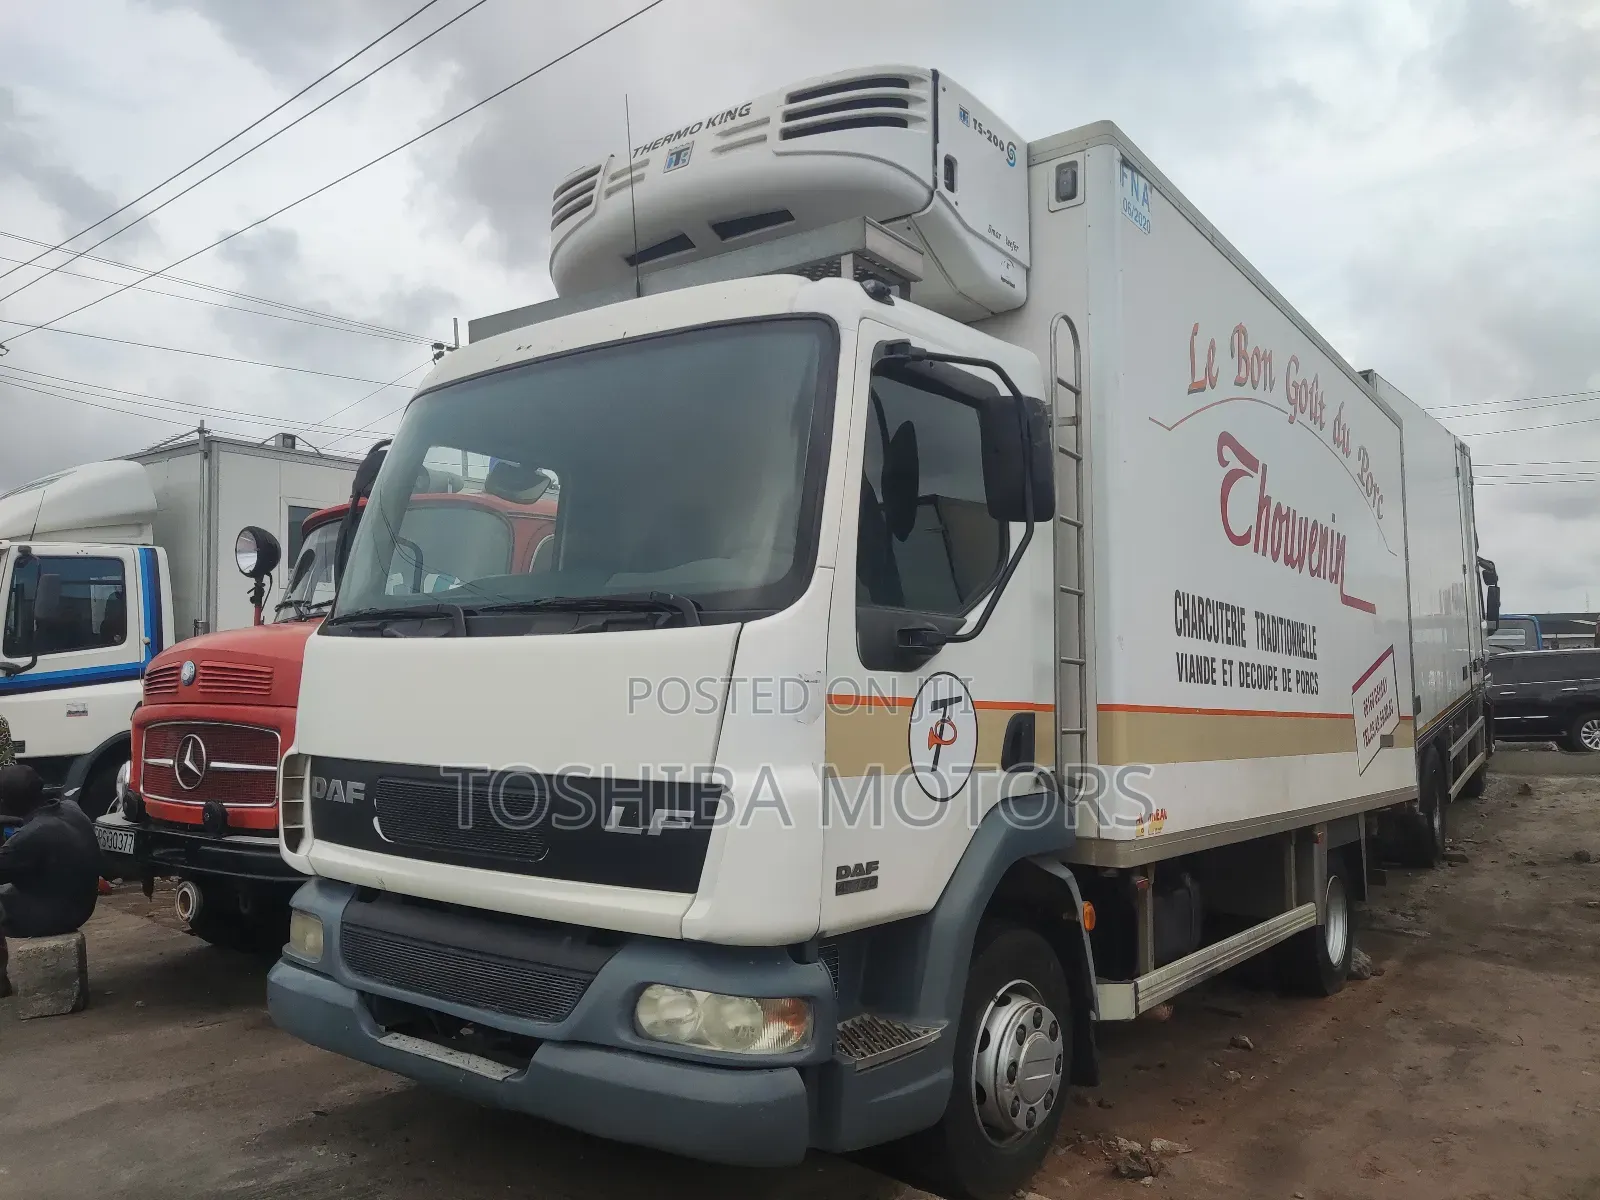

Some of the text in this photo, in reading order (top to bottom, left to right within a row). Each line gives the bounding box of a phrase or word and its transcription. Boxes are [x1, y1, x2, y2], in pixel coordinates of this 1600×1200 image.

[632, 102, 752, 158] THERMO KING
[973, 118, 1005, 152] TS-200
[1123, 197, 1151, 234] 06/2020
[1187, 322, 1219, 395] Le
[1230, 322, 1275, 393] Bon
[1333, 401, 1351, 458] du
[1357, 445, 1384, 519] Porc
[1216, 430, 1376, 615] Thouvenin
[1174, 589, 1317, 660] CHARCUTERIE TRADITIONNELLE
[1175, 652, 1319, 696] VIANDE ET DECOUPE DE PORCS
[312, 776, 366, 804] DAF
[604, 805, 696, 836] LF
[835, 860, 880, 880] DAF
